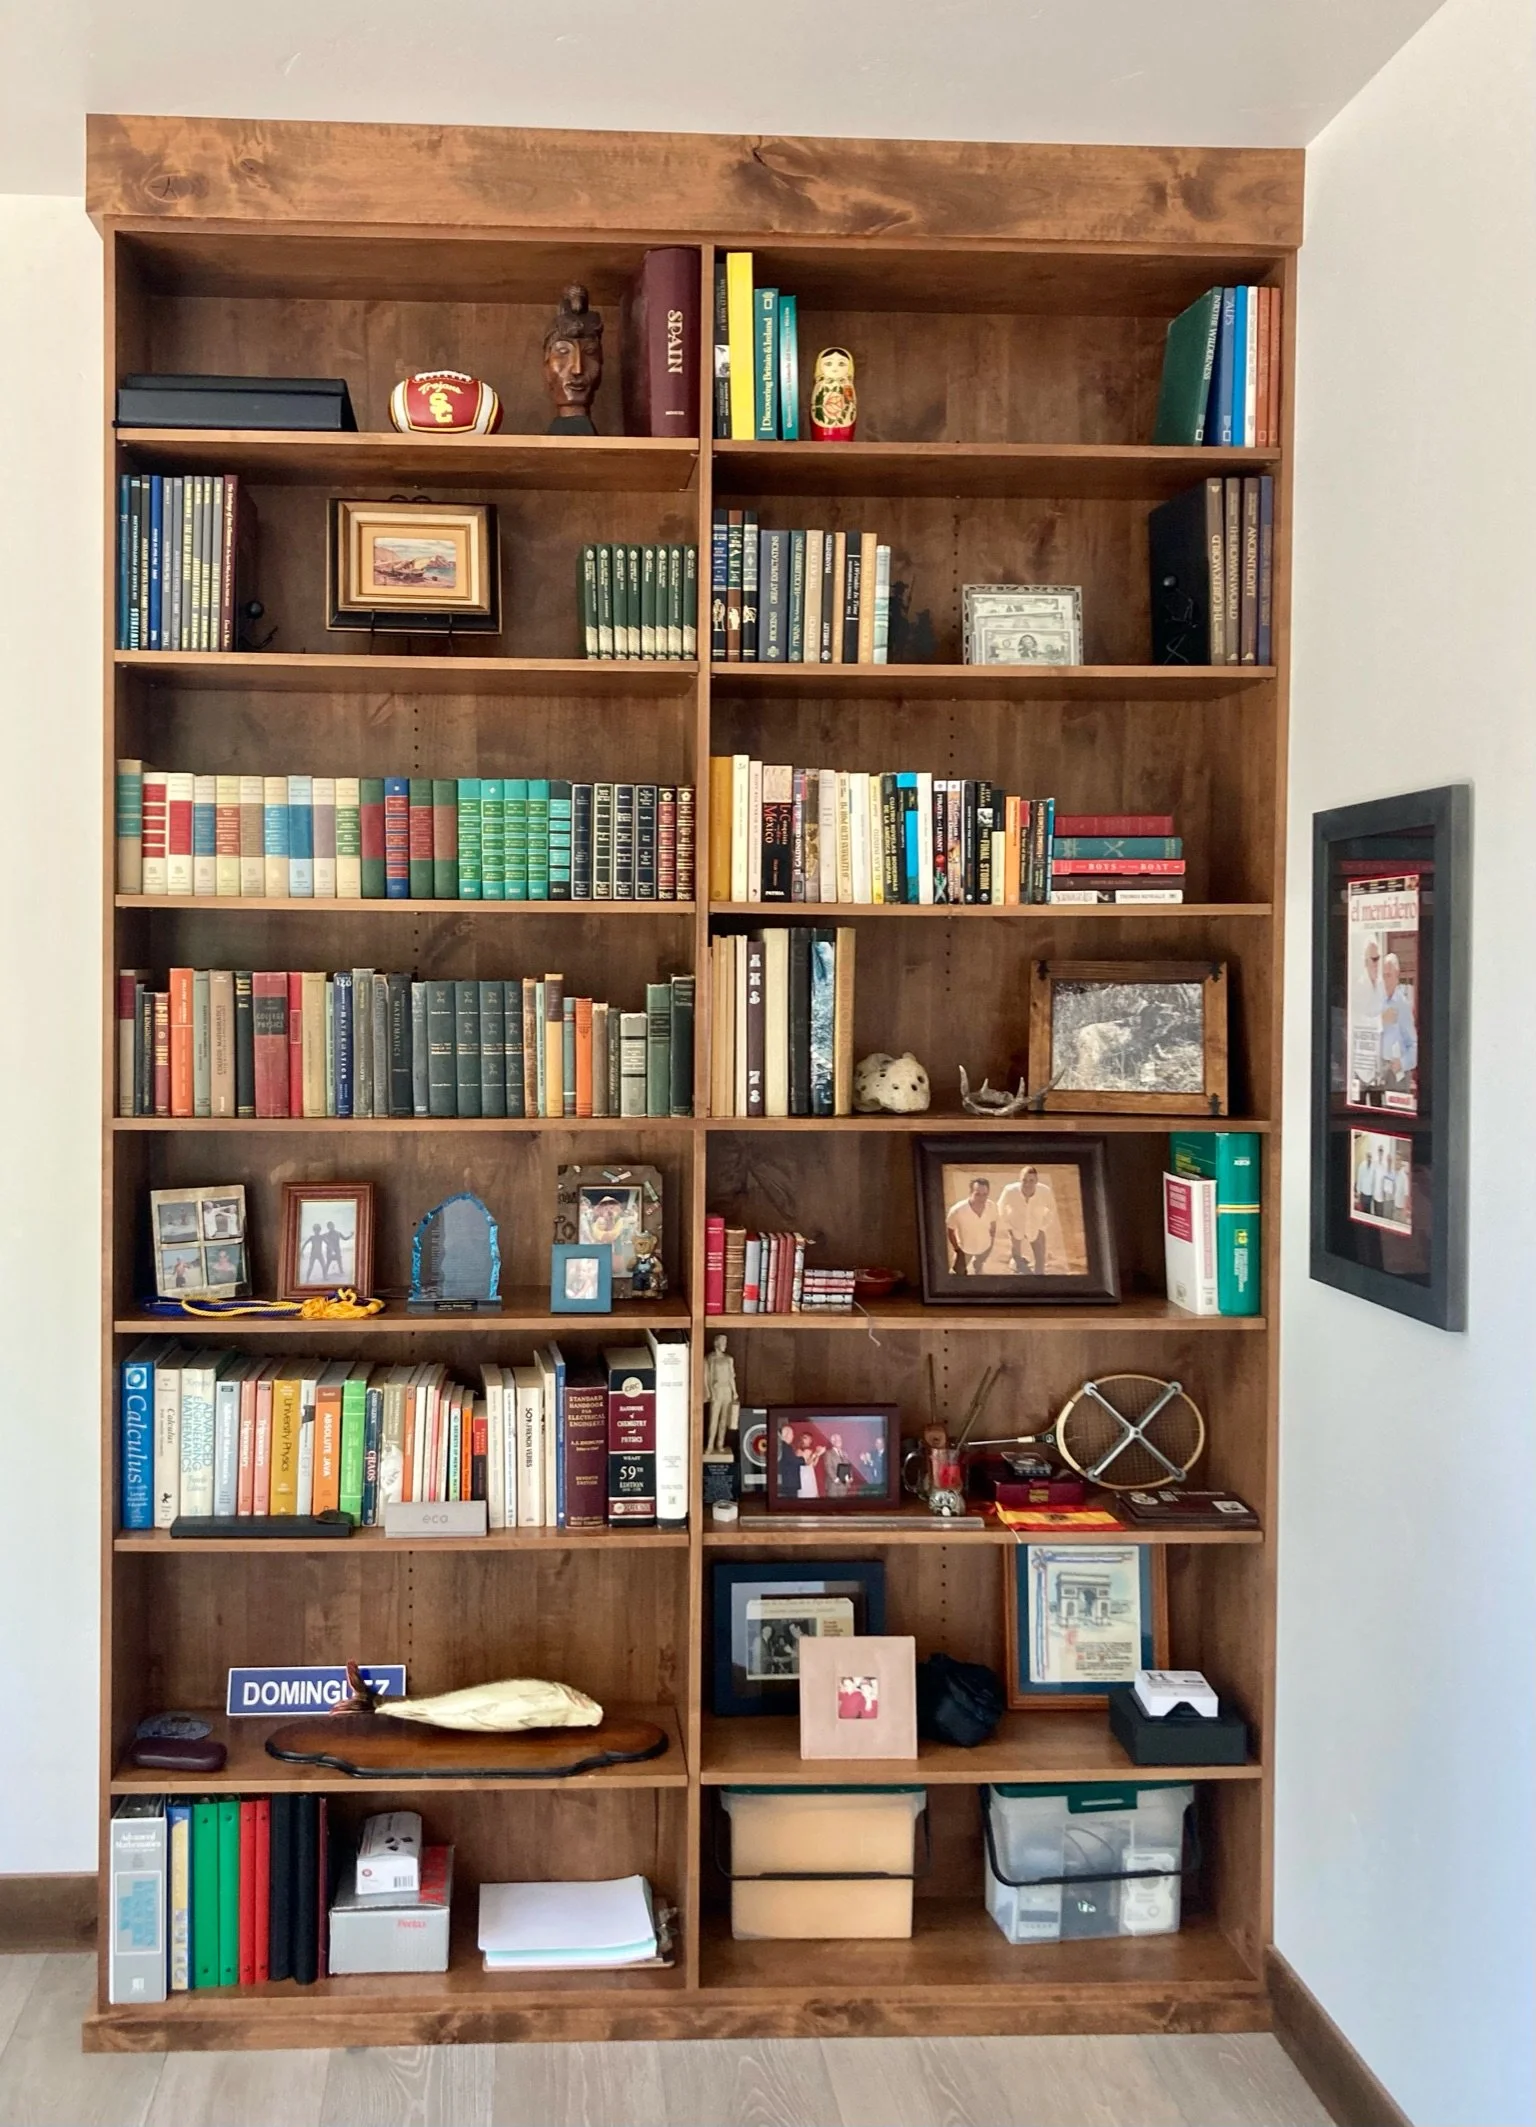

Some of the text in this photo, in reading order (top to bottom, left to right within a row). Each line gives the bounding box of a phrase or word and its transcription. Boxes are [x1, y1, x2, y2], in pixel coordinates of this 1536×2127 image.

[1224, 301, 1235, 326] ALPS
[667, 309, 684, 374] SPAIN
[762, 317, 773, 345] Ireland
[762, 353, 773, 381] Britain
[1203, 328, 1218, 381] WILDERNESS
[418, 381, 464, 395] Trojans
[763, 381, 773, 426] Discovering
[769, 535, 778, 582] EXPECTATIONS
[825, 534, 833, 574] FRANKENSTEIN
[1247, 526, 1257, 568] ANCIENT
[1211, 534, 1223, 622] THE GREEK WORLD
[769, 583, 778, 605] GREAT
[1230, 583, 1238, 620] WORLD
[884, 804, 890, 813] DE
[884, 815, 890, 824] LA
[763, 805, 778, 844] México
[884, 825, 892, 855] AMÉRICA
[980, 839, 990, 860] FINAL
[979, 863, 990, 890] STORM
[1087, 863, 1169, 871] BOYS BOAT
[1361, 896, 1417, 922] mentidero
[393, 1000, 401, 1057] MATHEMATICS
[624, 1383, 641, 1392] CRC
[166, 1408, 176, 1444] Calculus
[568, 1413, 606, 1421] ELECTRICAL
[569, 1420, 605, 1428] ENGINEERS
[617, 1420, 647, 1428] CHEMISTRY
[127, 1394, 147, 1484] Calculus
[182, 1394, 192, 1473] MATHEMATICS
[193, 1395, 203, 1471] ENGINEERING
[204, 1402, 214, 1468] ADVANCED
[241, 1420, 252, 1468] Trigonometry
[257, 1419, 267, 1466] Trigonometry
[280, 1398, 294, 1472] University Physics
[322, 1413, 331, 1477] ABSOLUTE JAVA
[620, 1436, 644, 1444] PHYSICS
[367, 1450, 377, 1481] CHAOS
[619, 1466, 645, 1481] 59TH
[243, 1679, 390, 1706] DOMINGZ
[115, 1841, 162, 1850] Mathematics
[120, 1831, 156, 1841] Advanced
